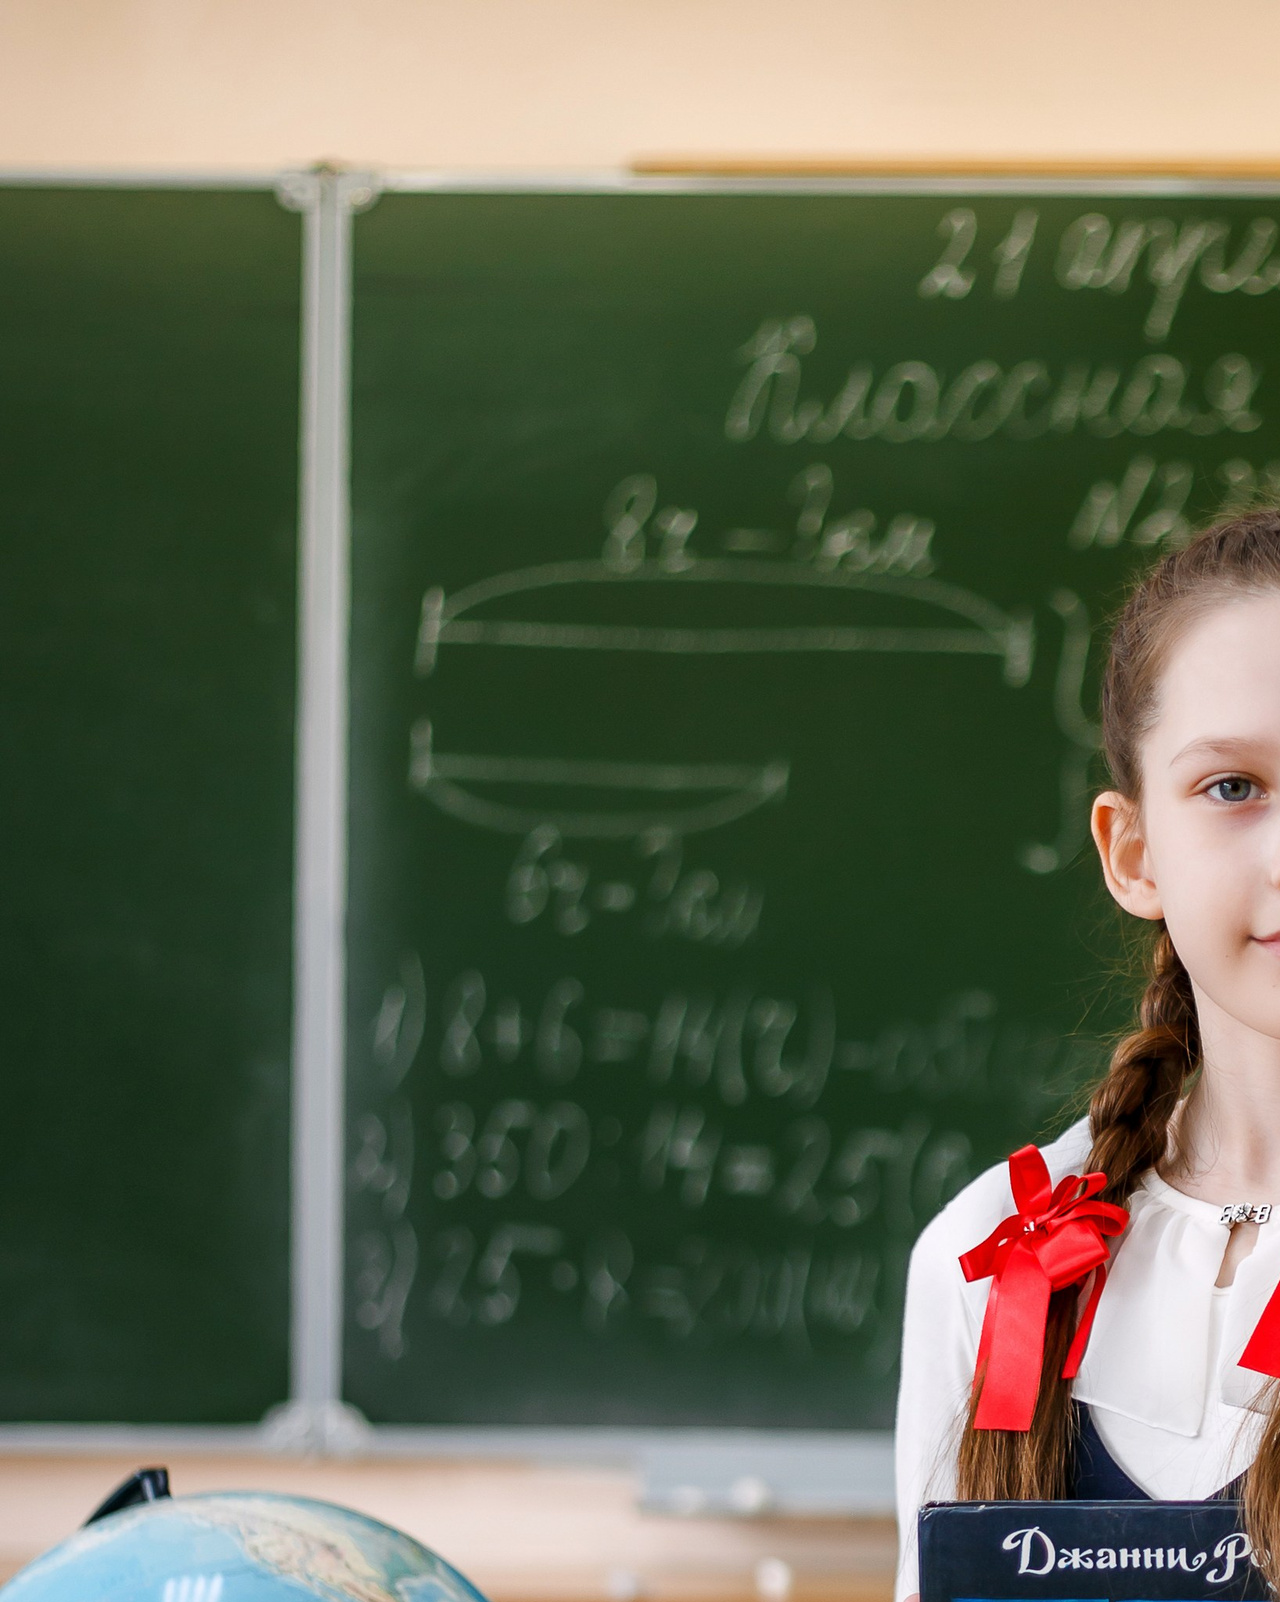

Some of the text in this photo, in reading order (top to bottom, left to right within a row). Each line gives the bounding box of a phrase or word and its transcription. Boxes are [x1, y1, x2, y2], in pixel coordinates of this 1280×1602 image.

[916, 205, 1041, 301] 21
[723, 313, 1264, 442] Классная
[1002, 1526, 1208, 1575] Джанни
